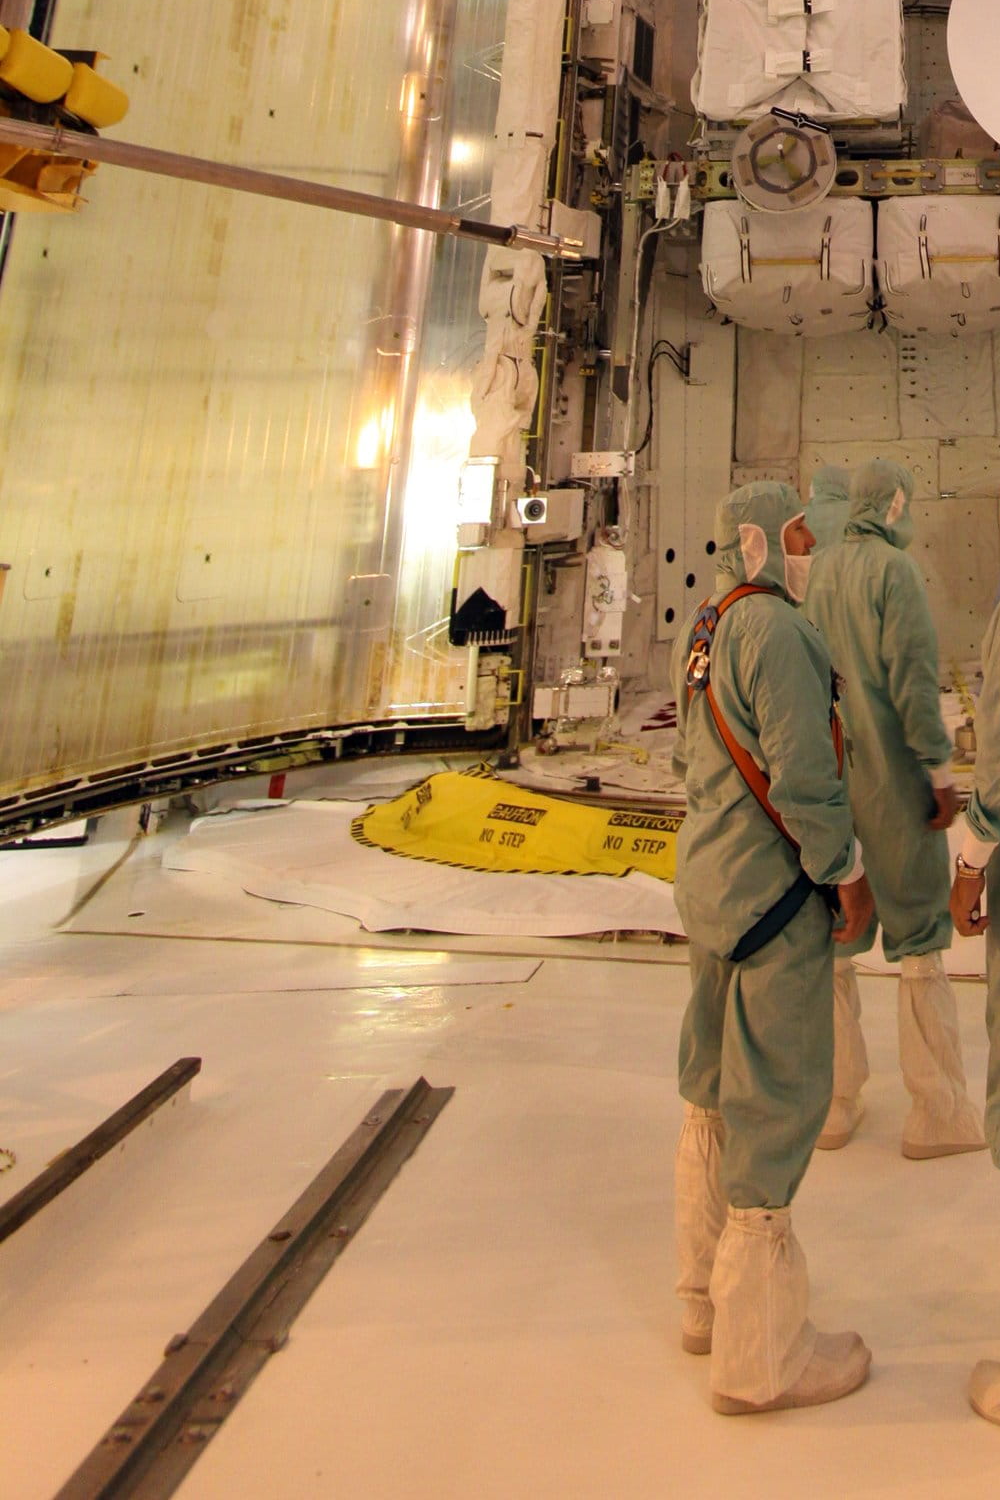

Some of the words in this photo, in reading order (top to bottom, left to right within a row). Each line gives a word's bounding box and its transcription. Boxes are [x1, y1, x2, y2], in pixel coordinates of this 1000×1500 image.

[489, 804, 547, 825] CAUTION
[610, 813, 682, 832] CAUTION
[479, 828, 495, 842] NO
[499, 831, 526, 848] STEP
[603, 835, 623, 850] NO
[631, 838, 667, 854] STEP
